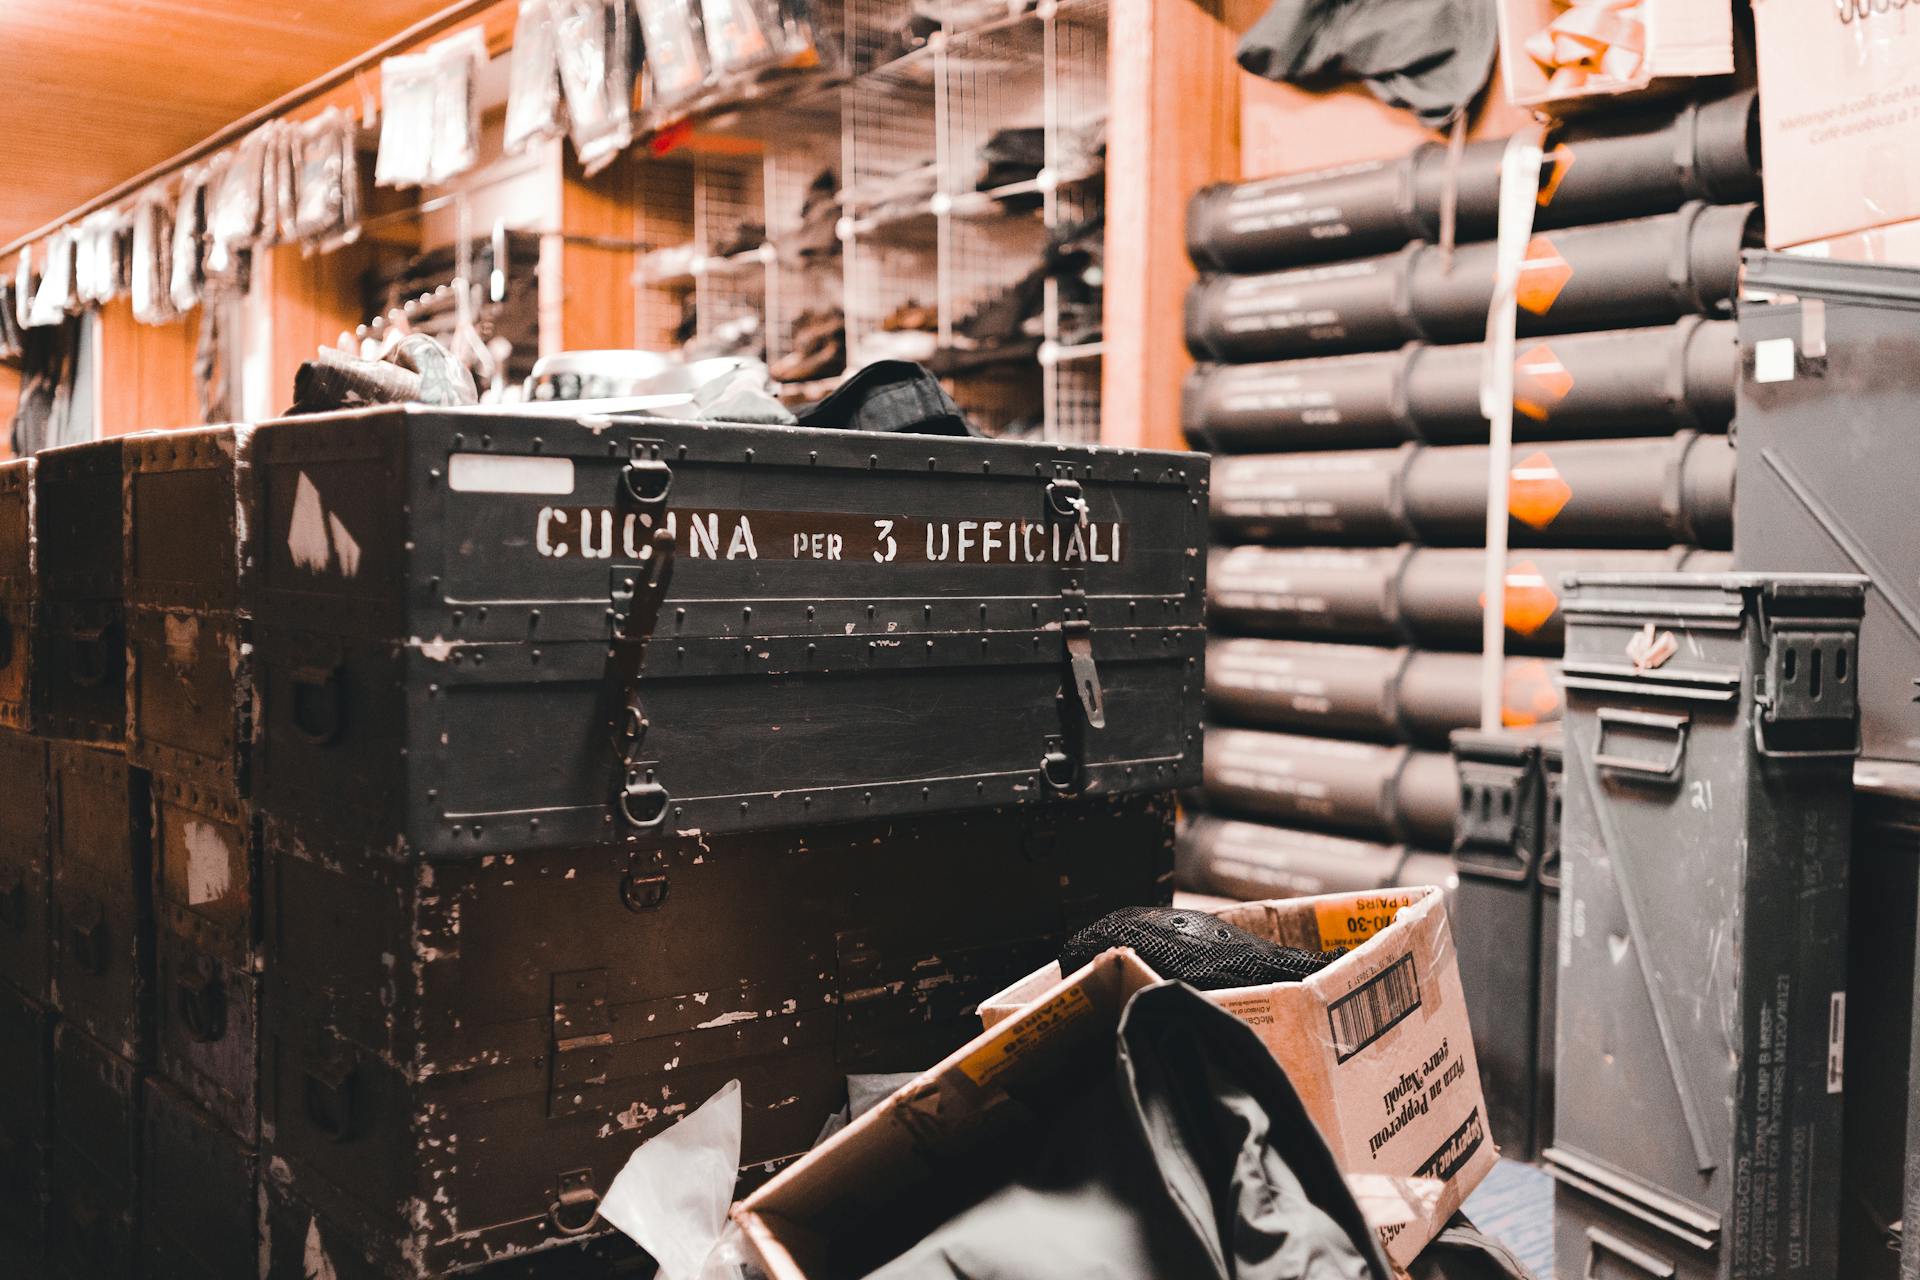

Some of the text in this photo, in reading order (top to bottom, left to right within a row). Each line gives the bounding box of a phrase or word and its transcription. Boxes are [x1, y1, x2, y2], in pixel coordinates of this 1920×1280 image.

[536, 505, 1121, 563] CUCINA PER 3 UFFICIALI
[1356, 896, 1397, 911] PAIRS
[1383, 1037, 1449, 1116] genre Napoli
[1759, 1052, 1772, 1065] B
[1368, 1054, 1466, 1160] Pizza au Pepperoni
[1789, 1243, 1802, 1269] LOT
